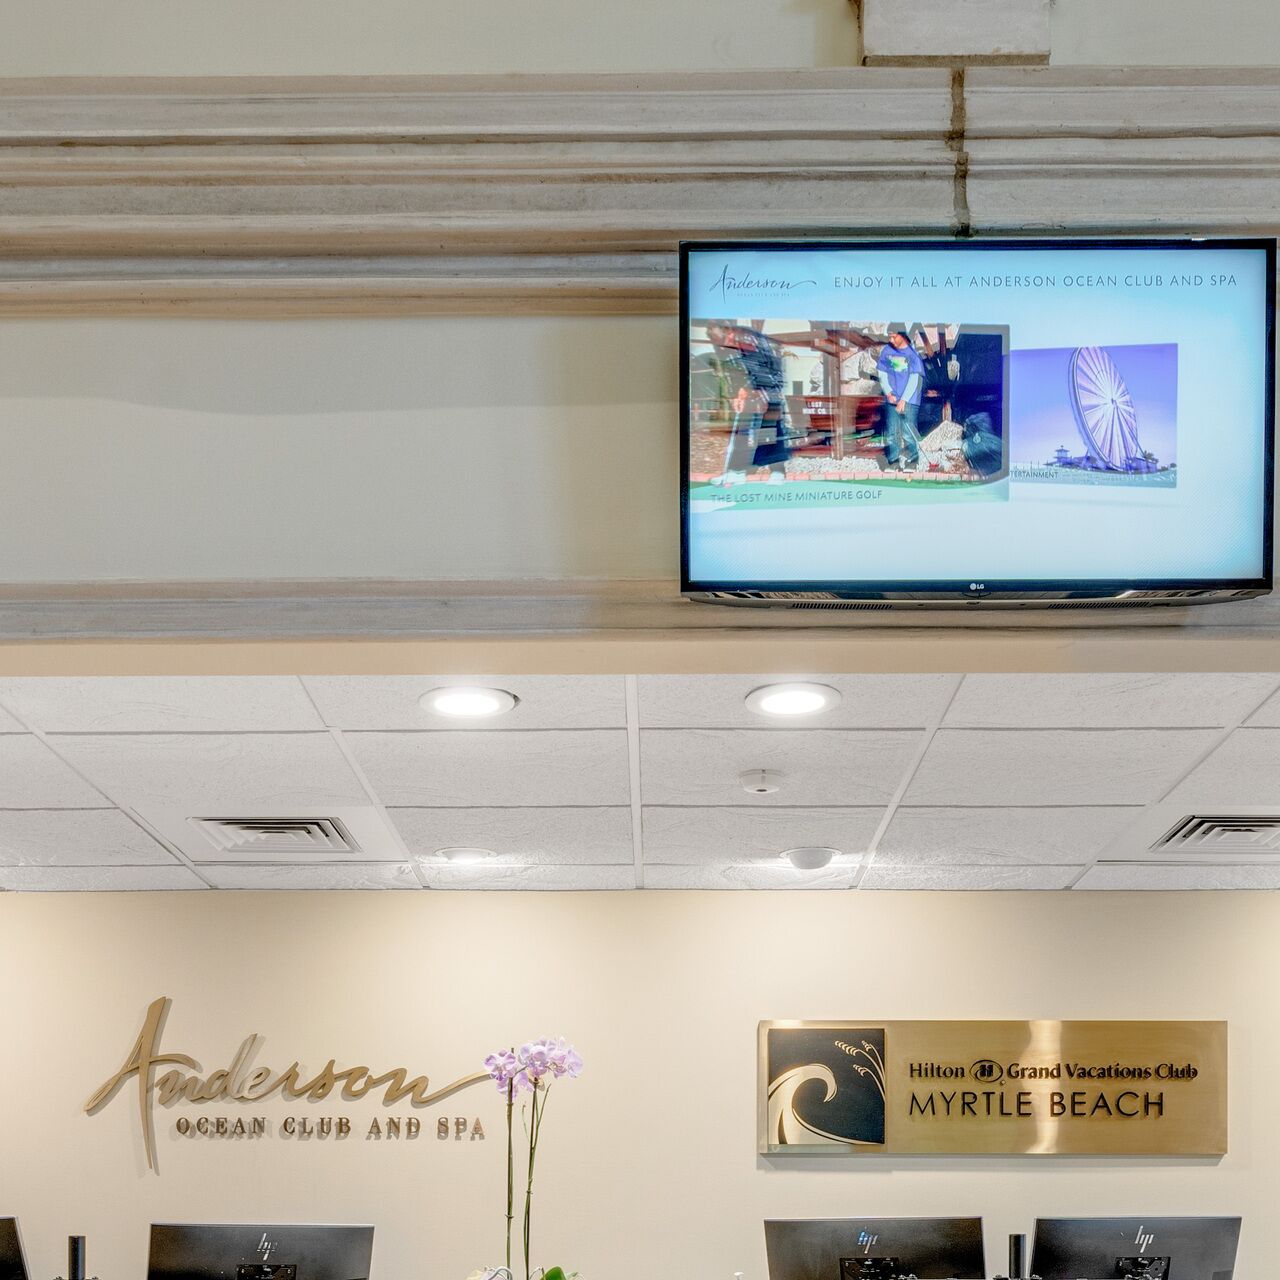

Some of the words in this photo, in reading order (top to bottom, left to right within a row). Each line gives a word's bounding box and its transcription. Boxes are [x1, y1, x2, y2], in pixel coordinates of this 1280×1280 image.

[709, 264, 817, 304] Anderson
[833, 276, 884, 289] ENJOY
[890, 276, 904, 288] IT
[911, 276, 938, 288] ALL
[944, 276, 963, 288] AT
[969, 276, 1056, 288] ANDERSON
[1063, 275, 1117, 287] OCEAN
[1124, 275, 1164, 287] CLUB
[1170, 275, 1204, 287] AND
[1210, 274, 1238, 287] SPA
[1009, 470, 1059, 480] TERTAINMENT
[710, 494, 732, 503] THE
[734, 493, 761, 503] LOST
[764, 492, 792, 502] MINE
[794, 490, 853, 501] MINIATURE
[855, 489, 883, 499] GOLF
[909, 1063, 966, 1079] Hilton
[1007, 1063, 1061, 1079] Grand
[1065, 1063, 1152, 1079] Vacations
[1155, 1063, 1199, 1079] Club
[83, 996, 492, 1169] Anderson
[908, 1091, 1033, 1117] MYRTLE
[1049, 1091, 1165, 1117] BEACH
[175, 1116, 268, 1136] OCEAN
[283, 1116, 352, 1136] CLUB
[369, 1116, 422, 1136] AND
[436, 1116, 486, 1136] SPA
